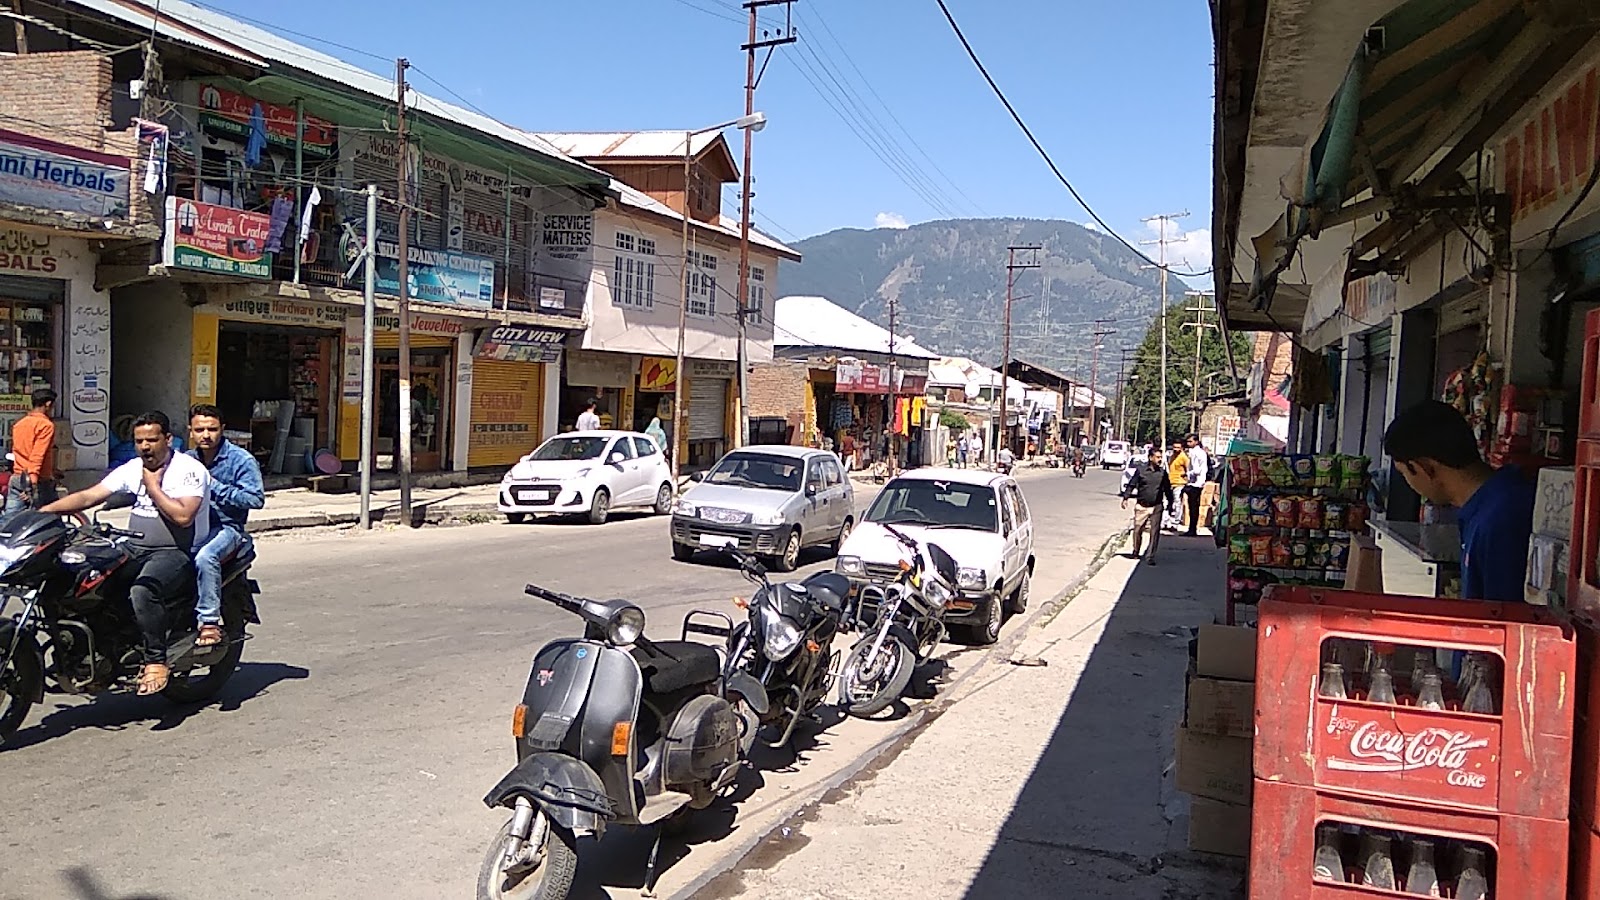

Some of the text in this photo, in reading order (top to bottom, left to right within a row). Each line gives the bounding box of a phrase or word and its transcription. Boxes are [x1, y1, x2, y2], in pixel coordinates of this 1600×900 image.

[208, 117, 242, 133] UNIFORM
[34, 159, 116, 192] Herbals
[543, 214, 591, 230] SERVICE
[543, 230, 592, 246] MATTERS
[271, 301, 314, 316] Hardware
[411, 316, 464, 333] Jewellers
[492, 327, 527, 341] CITY
[527, 330, 565, 344] VIEW
[1350, 720, 1488, 771] Coca-Cola
[1447, 769, 1486, 788] Coke
